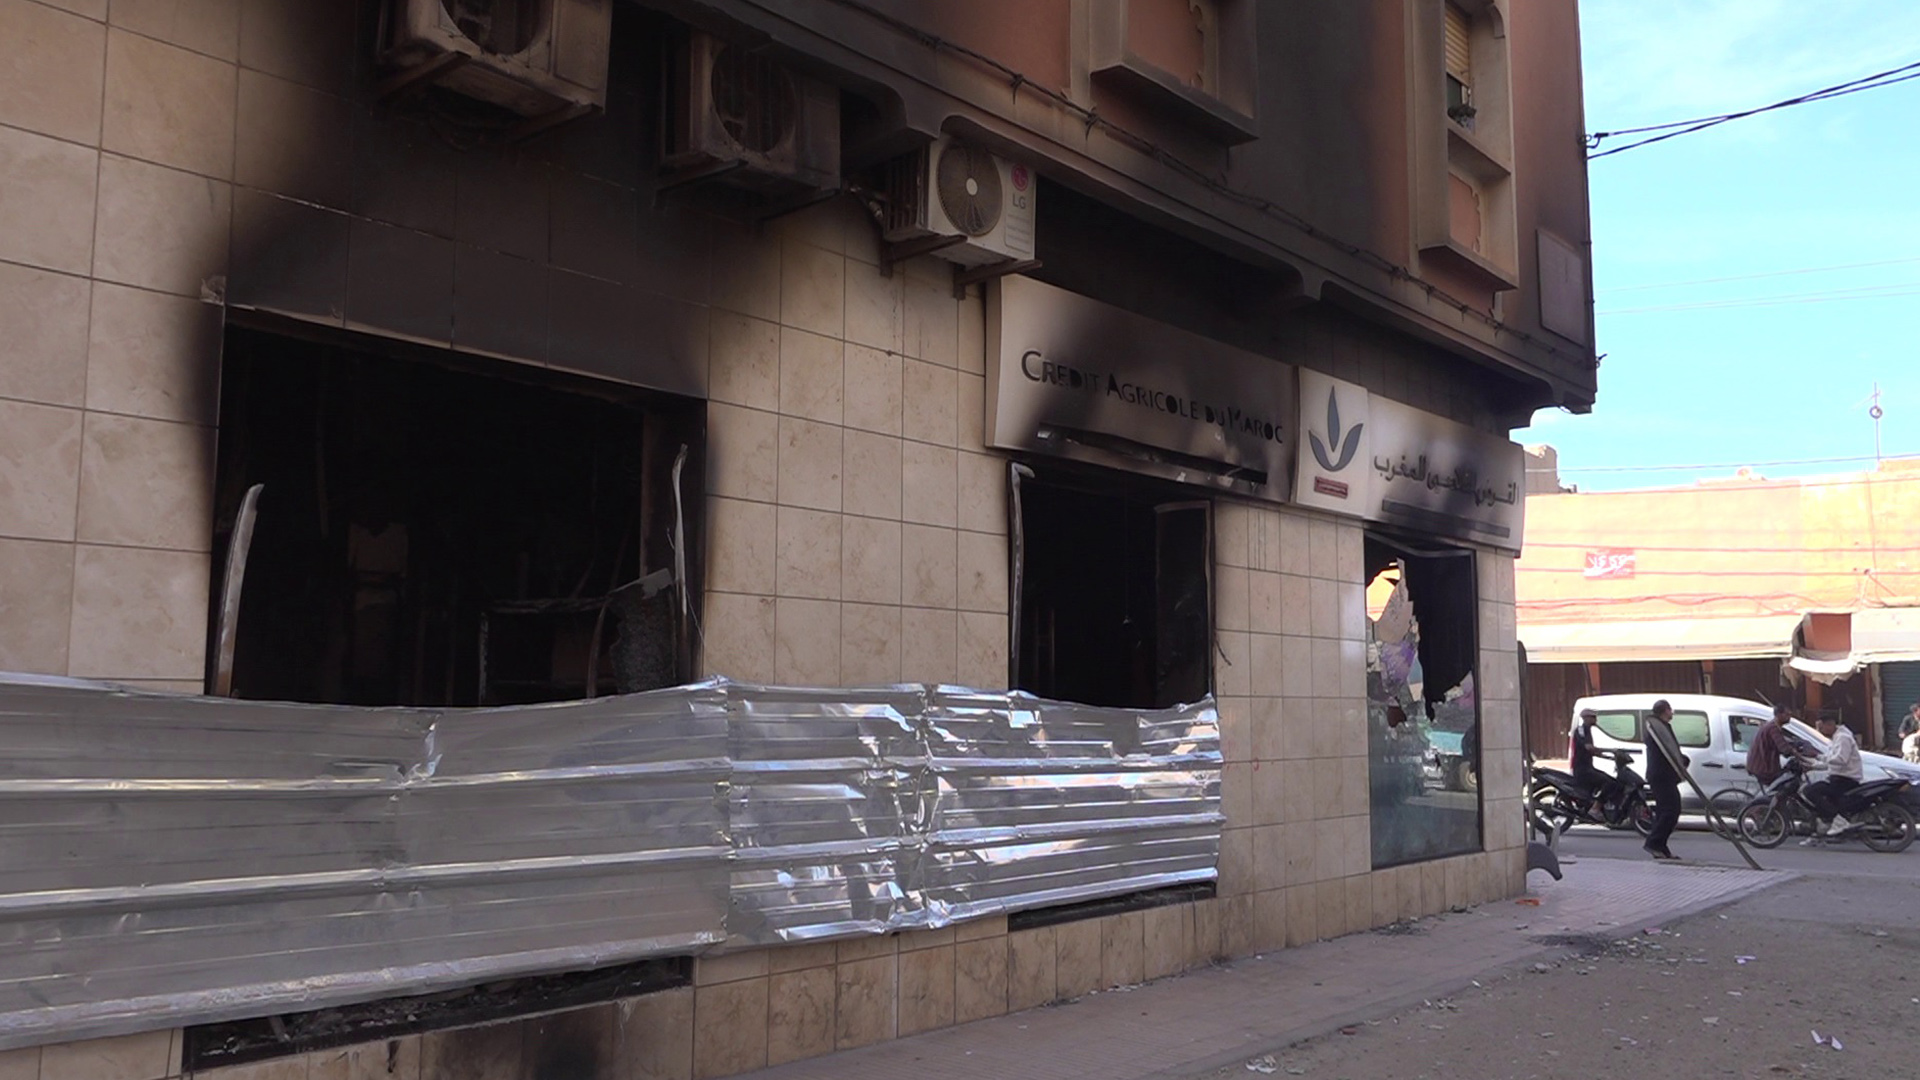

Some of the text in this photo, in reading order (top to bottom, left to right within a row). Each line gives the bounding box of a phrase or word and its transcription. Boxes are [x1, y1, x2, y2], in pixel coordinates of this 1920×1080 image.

[1012, 193, 1026, 210] LG
[1106, 374, 1198, 421] AGRICOLE
[1205, 405, 1225, 428] DU
[1227, 406, 1283, 445] MAROC
[1373, 454, 1427, 482] للمغرب
